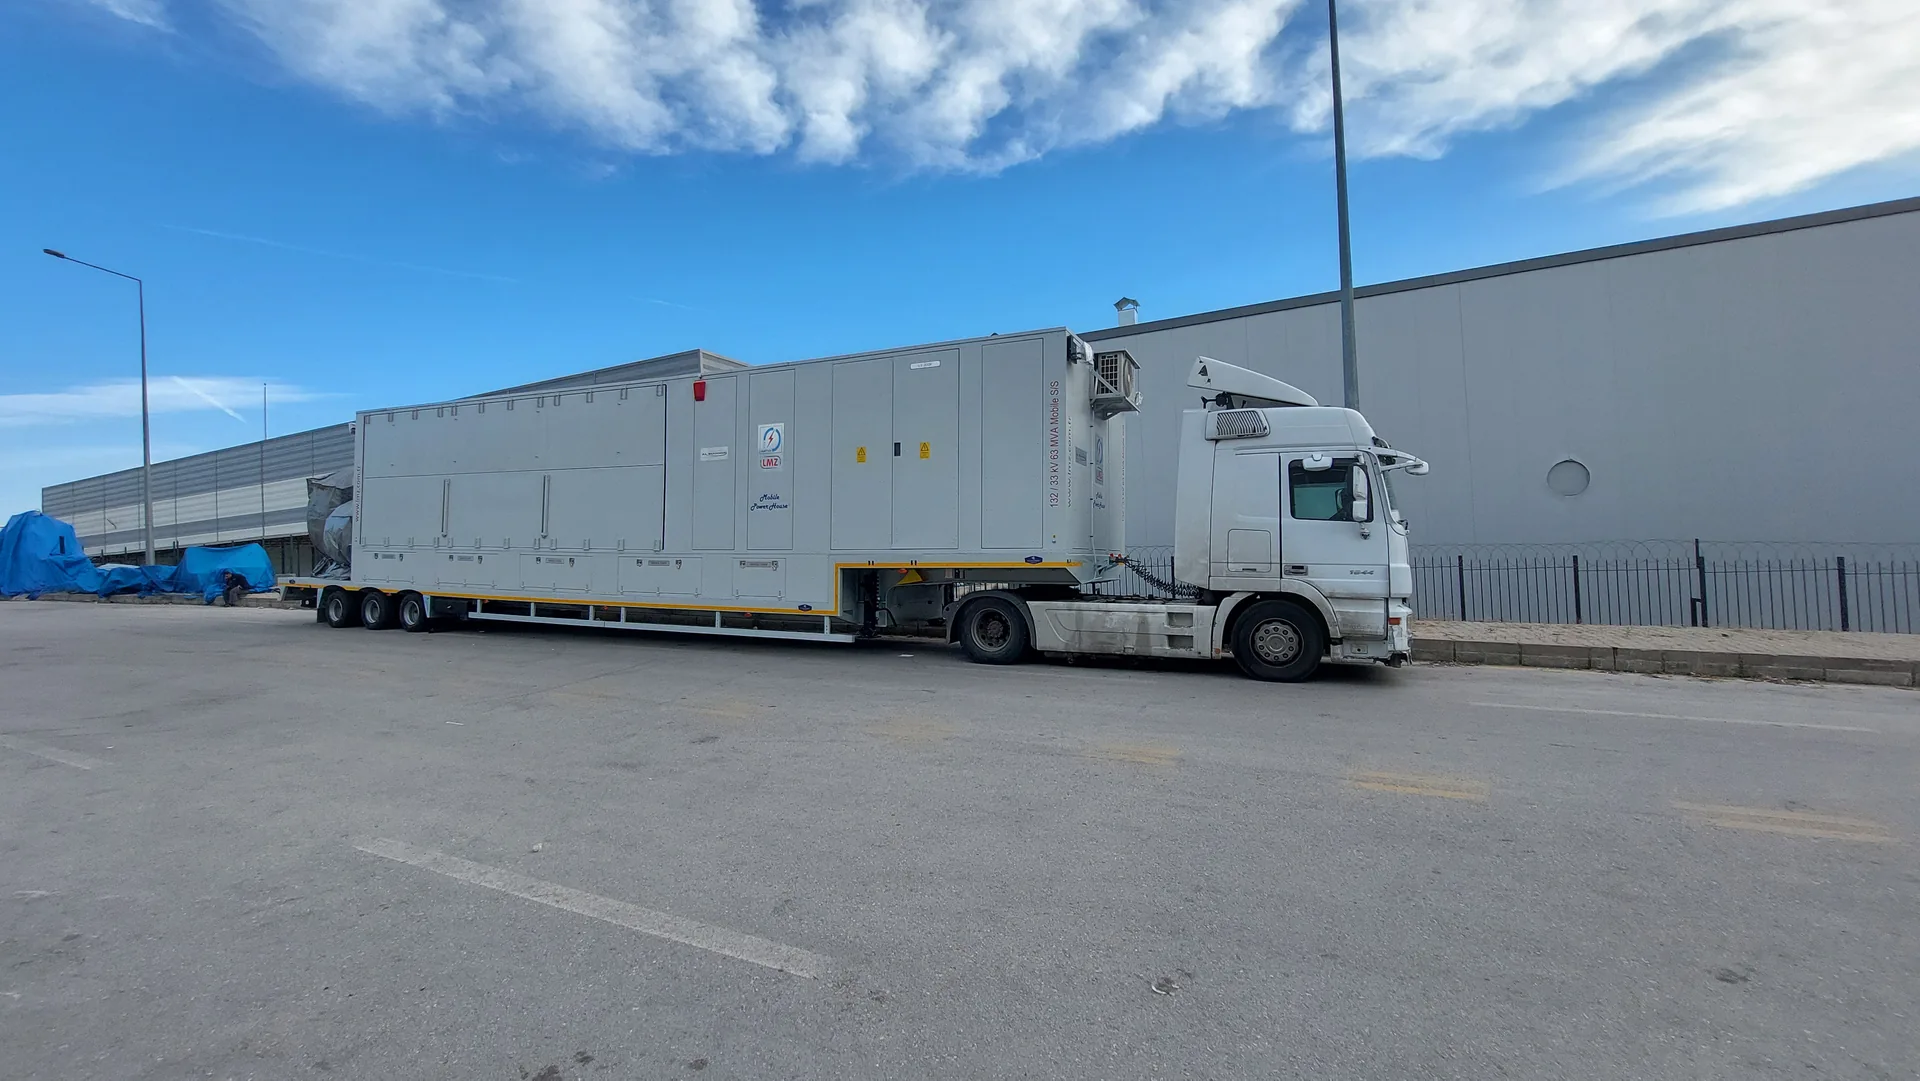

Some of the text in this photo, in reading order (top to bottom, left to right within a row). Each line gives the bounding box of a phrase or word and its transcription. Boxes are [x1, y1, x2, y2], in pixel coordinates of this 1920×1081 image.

[1050, 380, 1059, 395] S/S
[1050, 397, 1059, 425] Mobile
[1050, 426, 1058, 447] MVA
[1050, 449, 1058, 460] 63
[762, 458, 778, 467] LMZ
[1050, 462, 1058, 473] kV
[1050, 475, 1058, 486] 33
[760, 493, 780, 502] Mobile
[1050, 492, 1058, 507] 132
